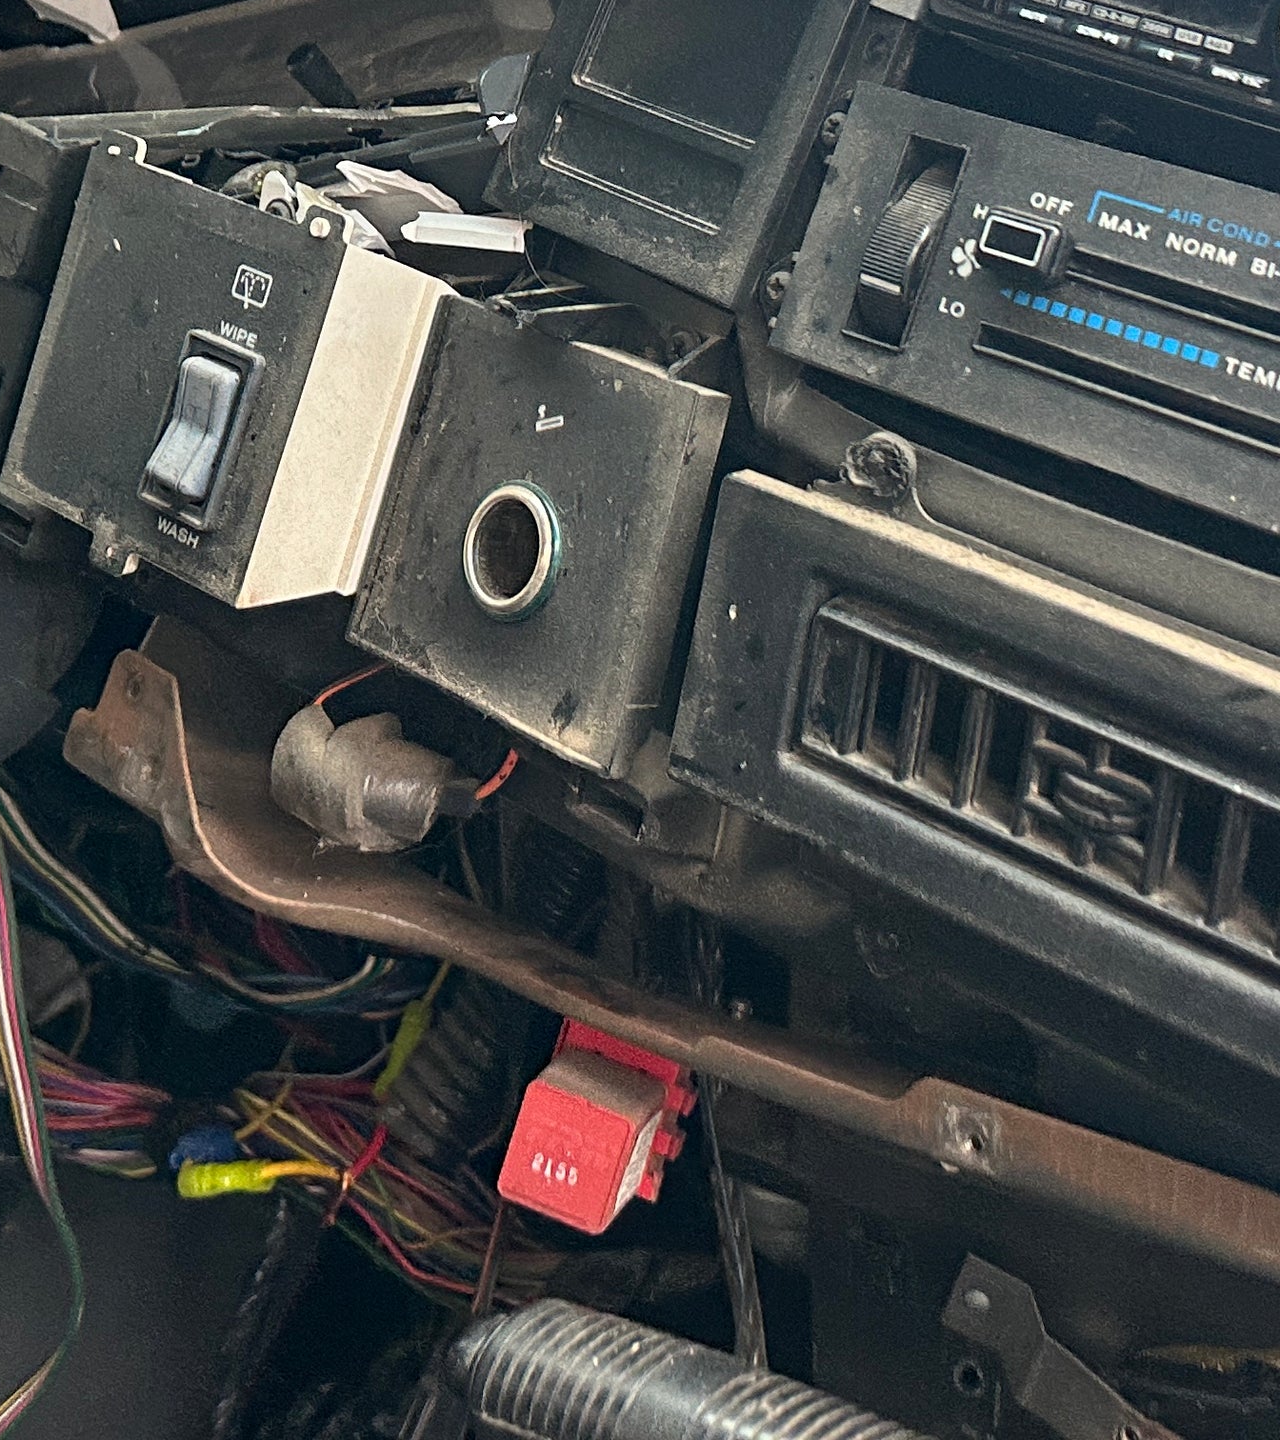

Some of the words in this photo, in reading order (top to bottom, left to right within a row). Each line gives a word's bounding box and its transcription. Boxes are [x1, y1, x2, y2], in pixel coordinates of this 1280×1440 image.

[972, 202, 989, 221] H
[1030, 191, 1074, 217] OFF
[1097, 212, 1152, 241] MAX
[1165, 232, 1238, 268] NORM
[1167, 208, 1203, 230] AIR
[1206, 217, 1271, 248] COND
[938, 296, 966, 319] LO
[219, 320, 258, 349] WIPE
[157, 516, 200, 549] WASH
